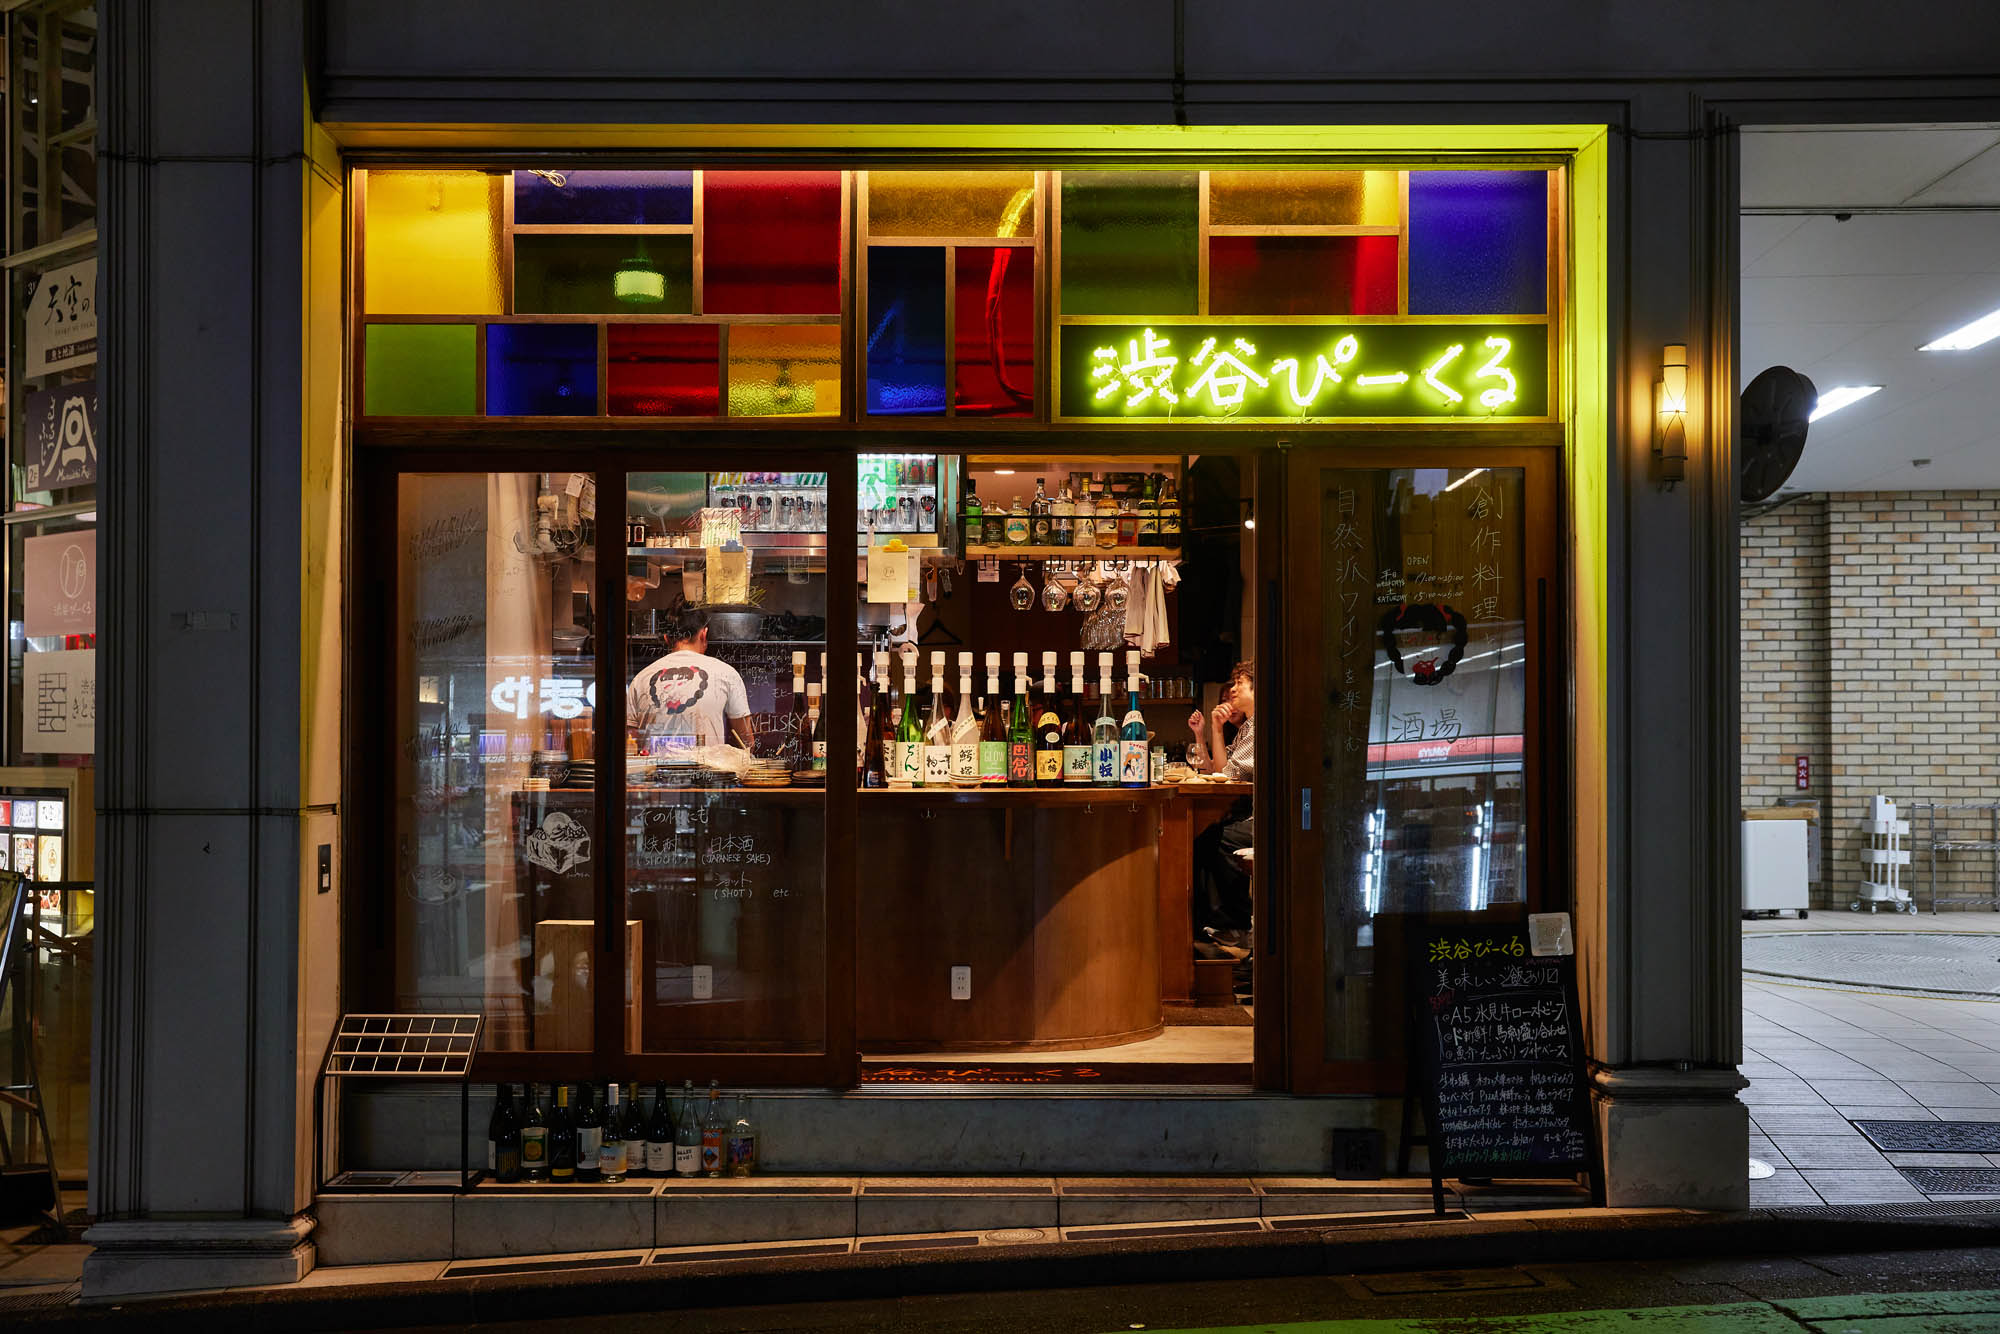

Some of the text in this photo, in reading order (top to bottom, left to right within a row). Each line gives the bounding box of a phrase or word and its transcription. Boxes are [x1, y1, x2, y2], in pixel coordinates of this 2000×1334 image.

[1092, 328, 1518, 407] 渋谷ぴーくる
[1407, 555, 1430, 566] OPEN
[744, 711, 807, 733] WHISKY
[1391, 708, 1462, 744] 酒場
[711, 833, 754, 854] 日本酒
[1429, 936, 1525, 963] 渋谷ぴーくる
